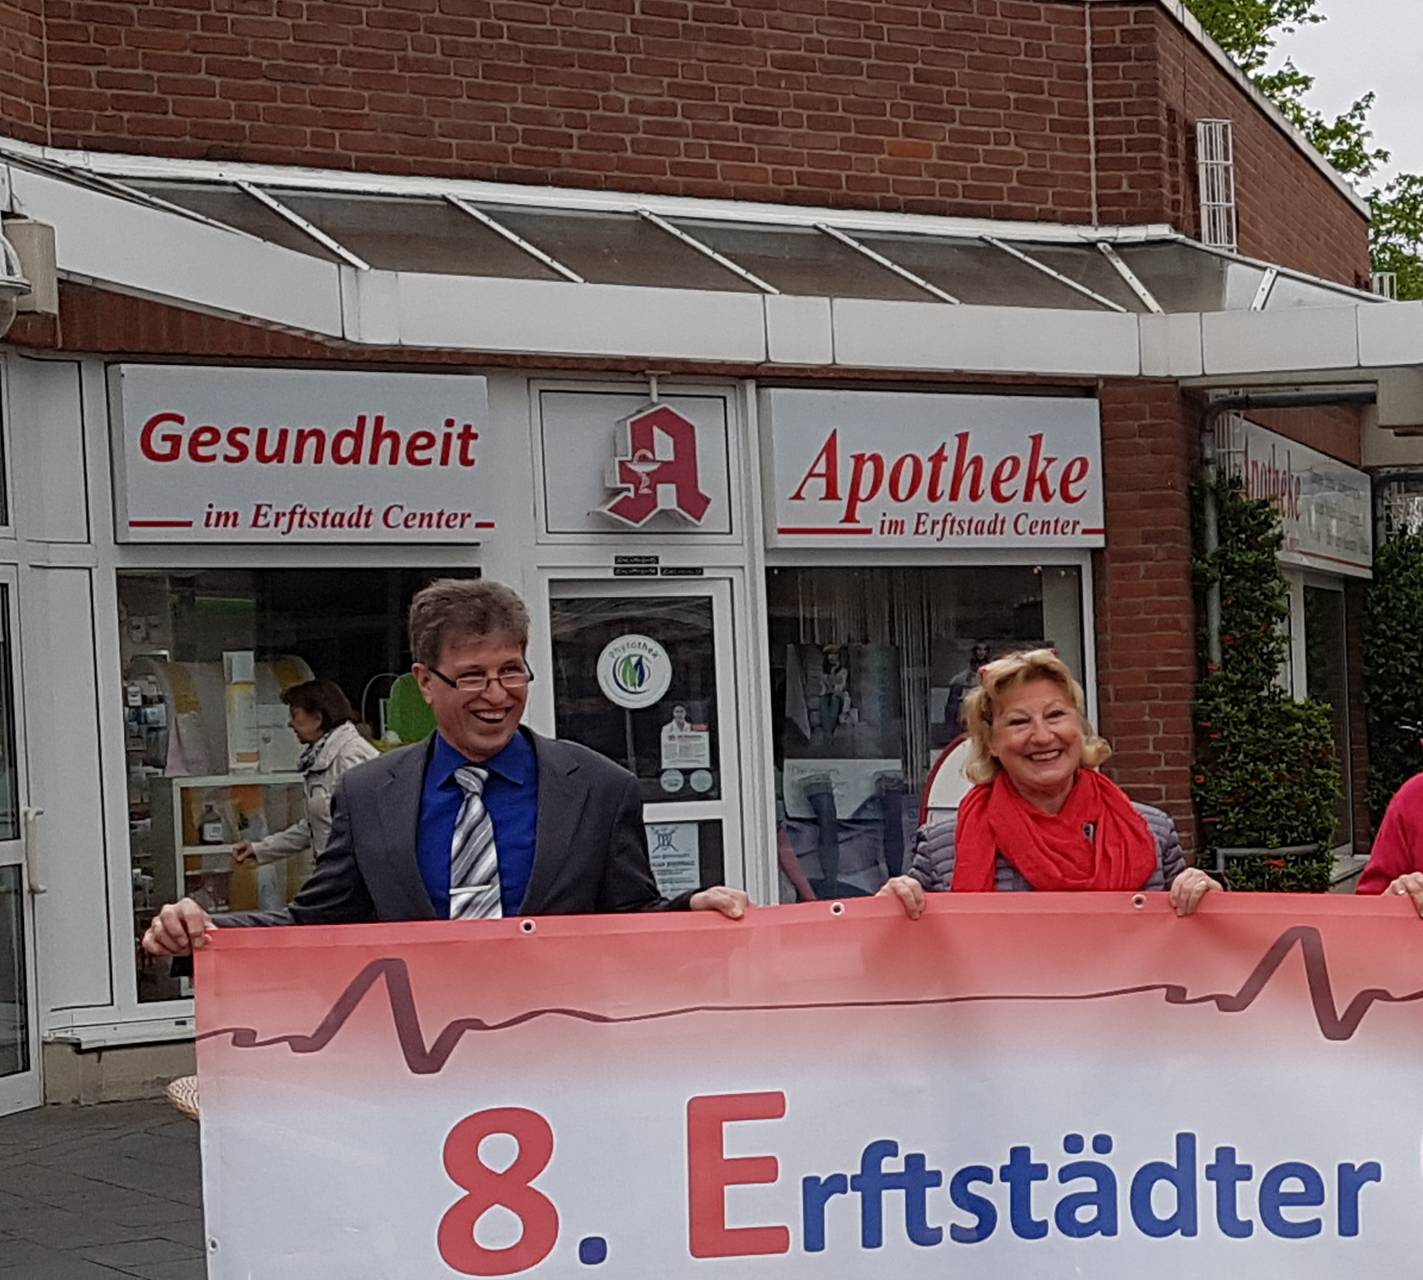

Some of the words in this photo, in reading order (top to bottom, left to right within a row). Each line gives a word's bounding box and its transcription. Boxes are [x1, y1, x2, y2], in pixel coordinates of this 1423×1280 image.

[140, 412, 480, 468] Gesundheit
[606, 405, 713, 527] A
[789, 428, 1090, 524] Apotheke
[203, 503, 240, 528] im
[251, 504, 373, 535] Erftstadt
[382, 505, 472, 529] Center
[879, 512, 905, 536] im
[913, 512, 1006, 542] Erftstadt
[1013, 513, 1080, 536] Center
[435, 1105, 607, 1277] 8.
[685, 1090, 1382, 1259] Erftstädter
